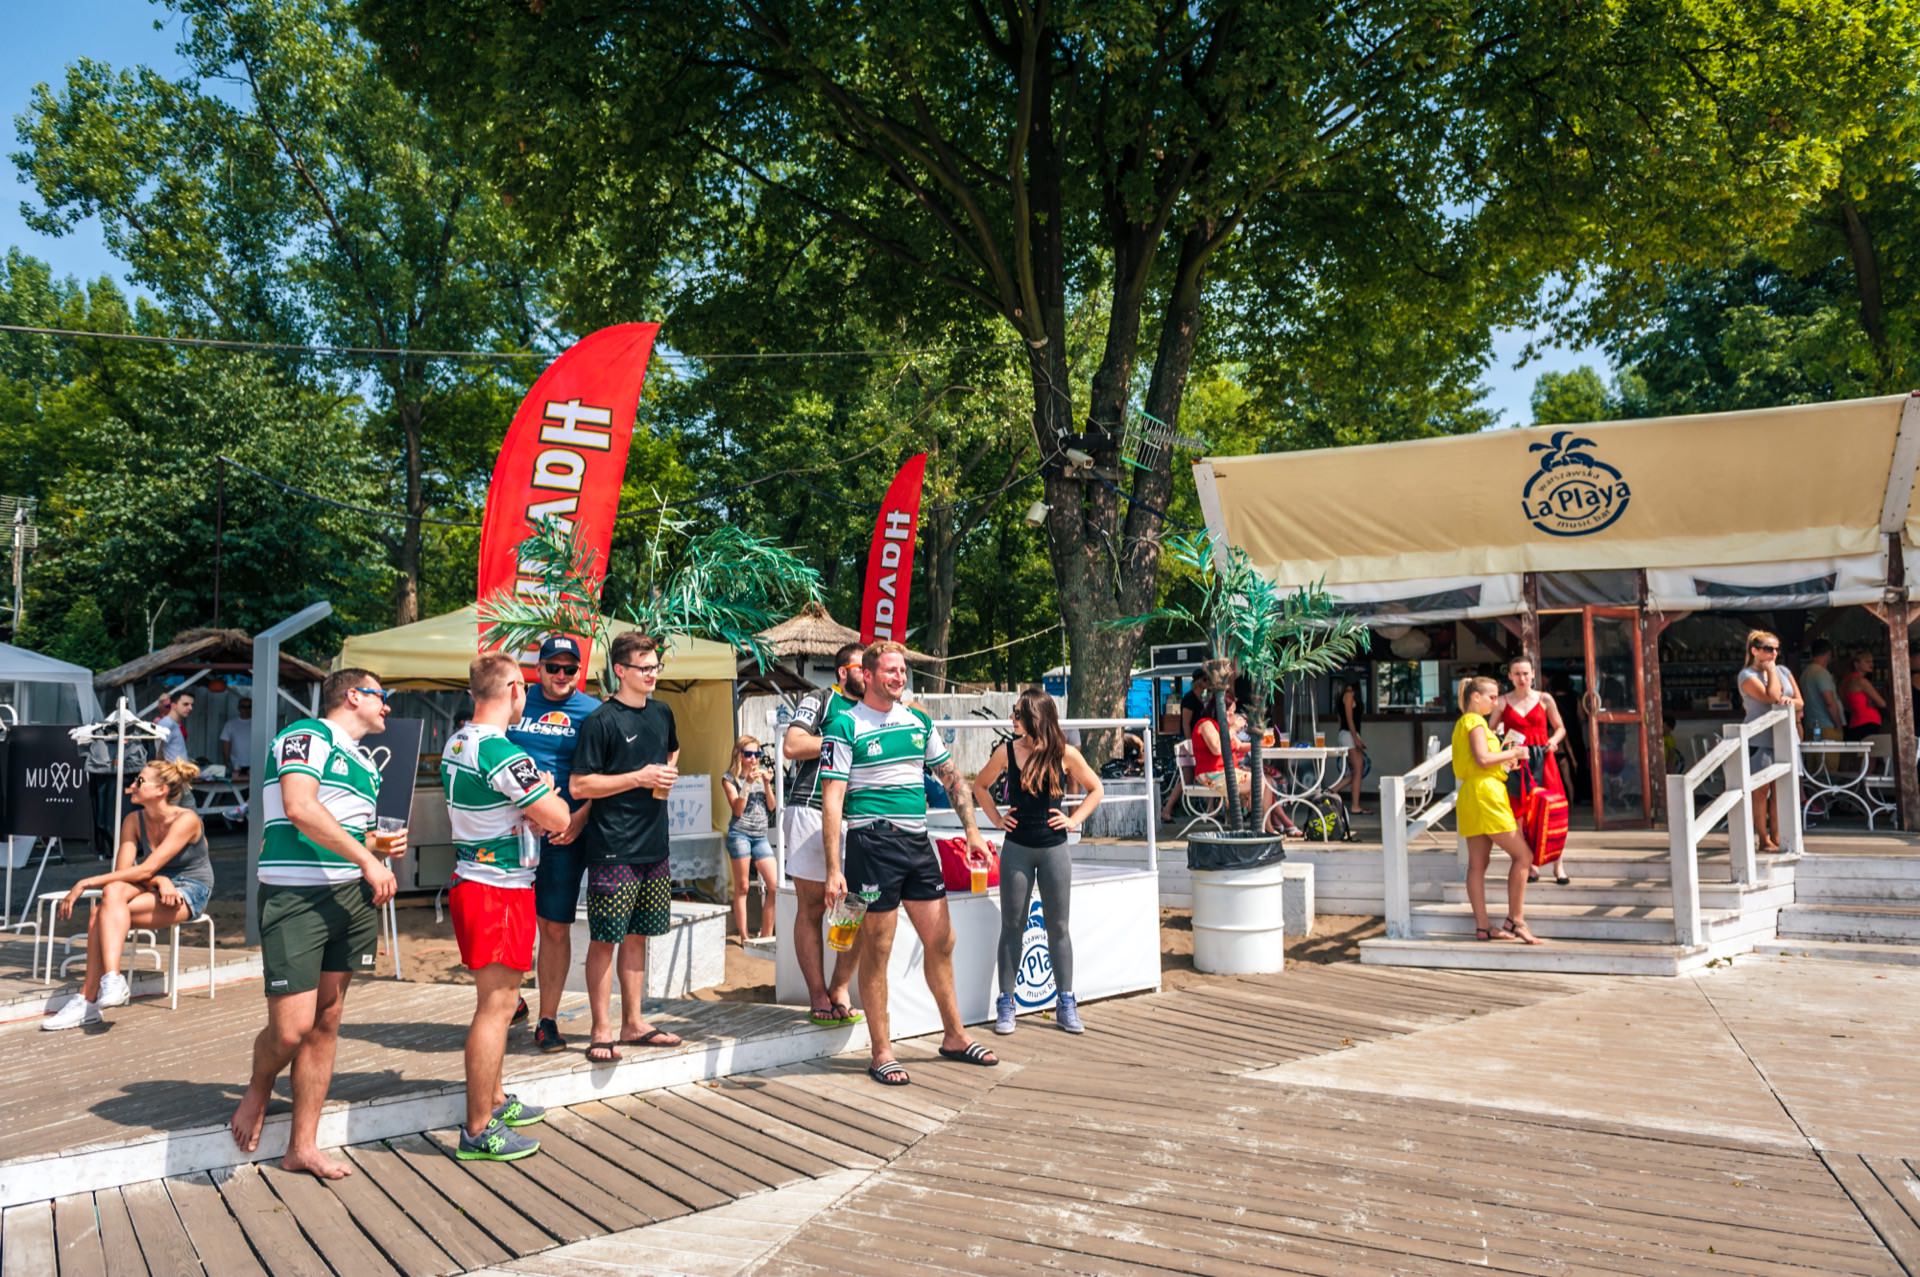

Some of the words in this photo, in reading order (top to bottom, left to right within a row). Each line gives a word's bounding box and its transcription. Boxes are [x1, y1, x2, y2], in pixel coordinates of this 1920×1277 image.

[1538, 469, 1600, 491] warszawska
[1521, 500, 1554, 520] La
[1557, 481, 1631, 512] Playa
[1556, 519, 1594, 529] music
[1593, 509, 1611, 523] bar
[508, 716, 576, 737] ellesse
[1027, 951, 1052, 979] Pla
